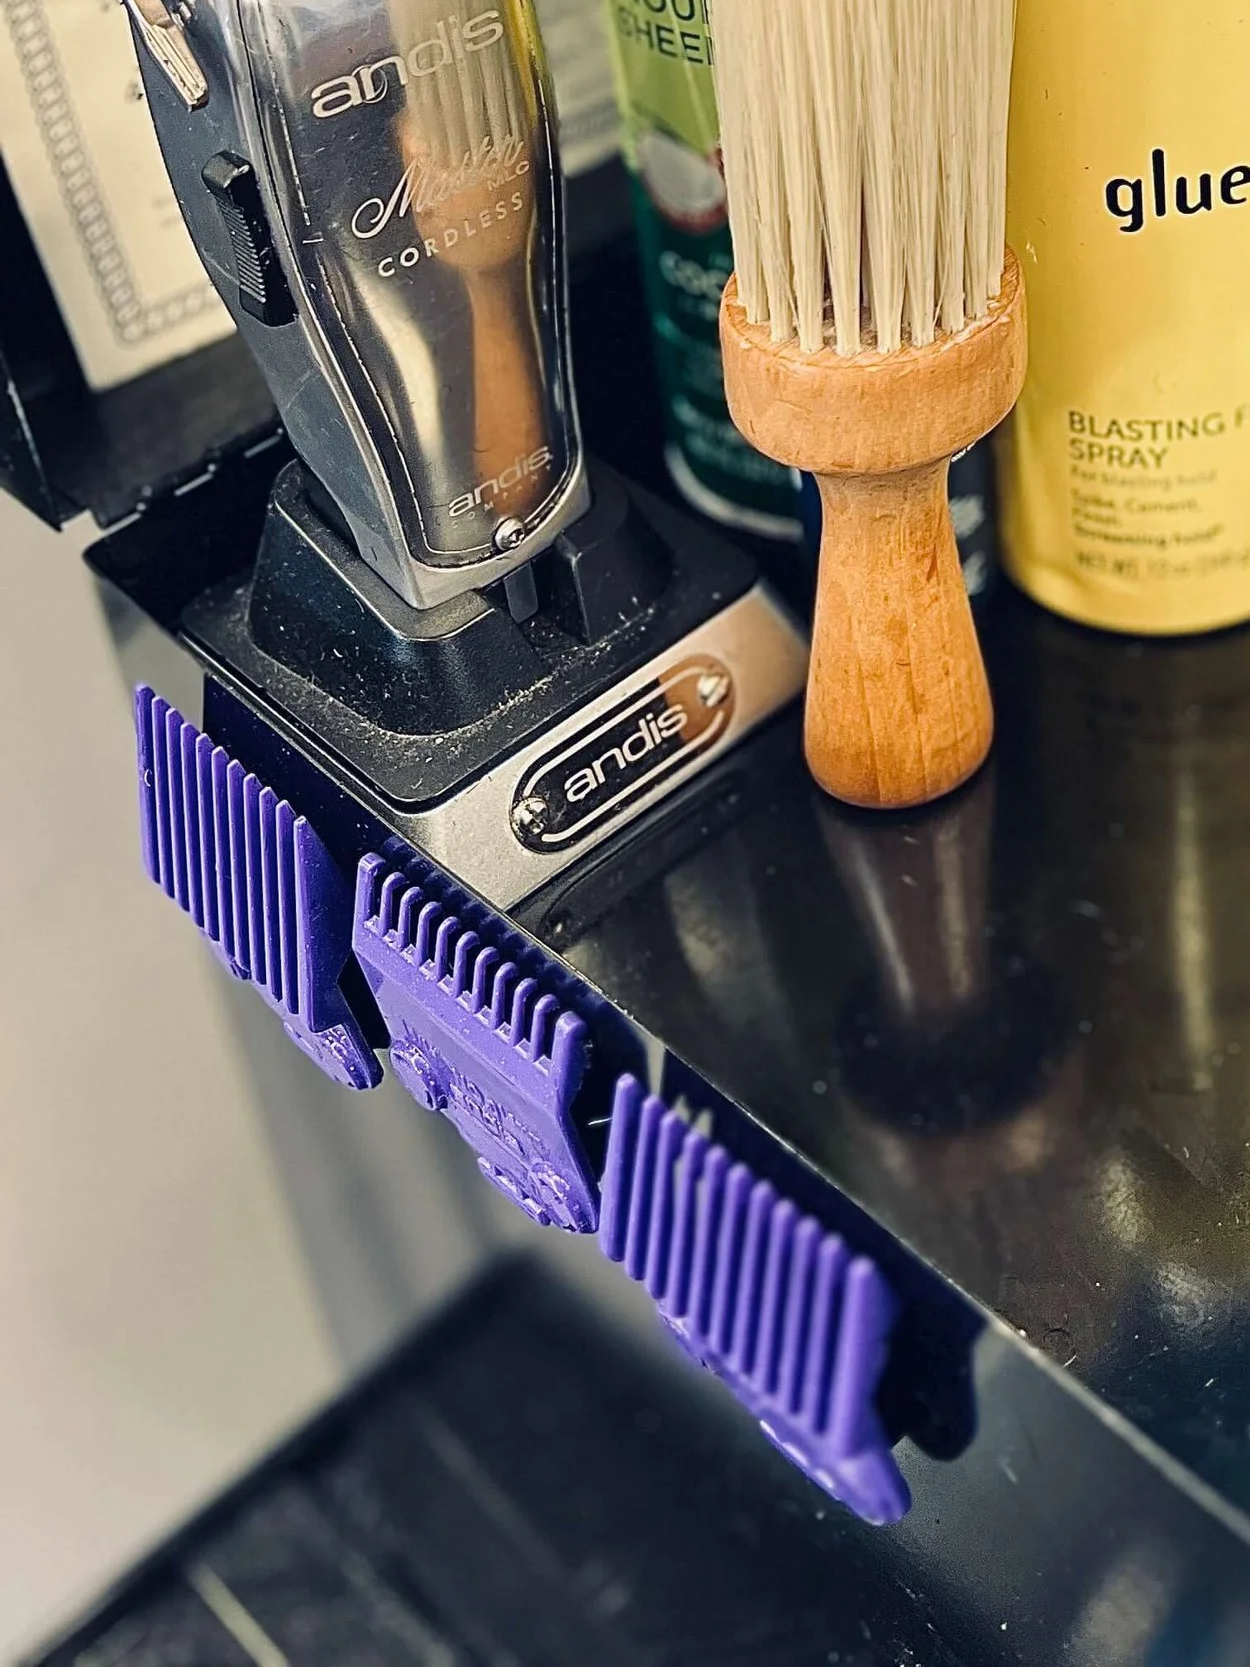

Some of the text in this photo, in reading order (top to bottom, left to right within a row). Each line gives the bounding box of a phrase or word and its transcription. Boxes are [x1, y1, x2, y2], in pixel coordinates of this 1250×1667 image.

[310, 9, 504, 119] andis
[378, 191, 524, 278] CORDLESS
[1068, 410, 1226, 442] BLASTING
[1068, 436, 1169, 469] SPRAY
[448, 445, 554, 518] andis
[564, 703, 688, 803] andis
